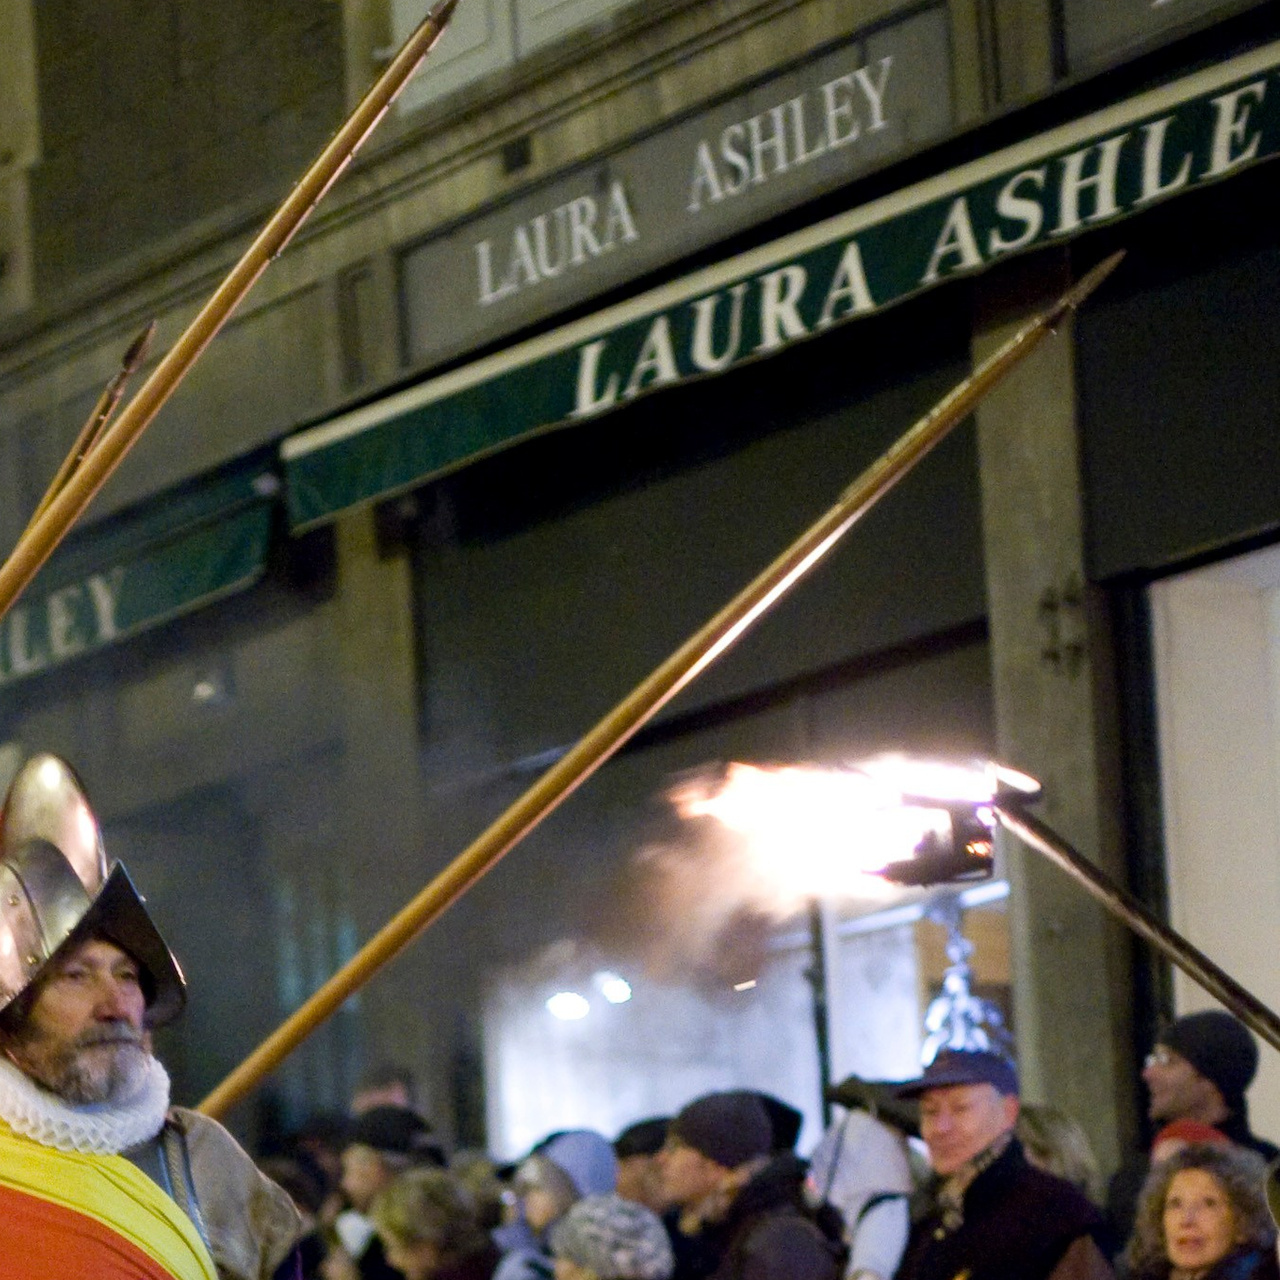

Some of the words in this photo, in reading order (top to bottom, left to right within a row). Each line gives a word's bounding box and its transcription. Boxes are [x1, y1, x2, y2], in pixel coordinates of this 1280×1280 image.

[474, 180, 639, 307] LAURA
[687, 56, 894, 214] ASHLEY
[566, 240, 877, 420] LAURA
[919, 76, 1280, 286] ASHLE
